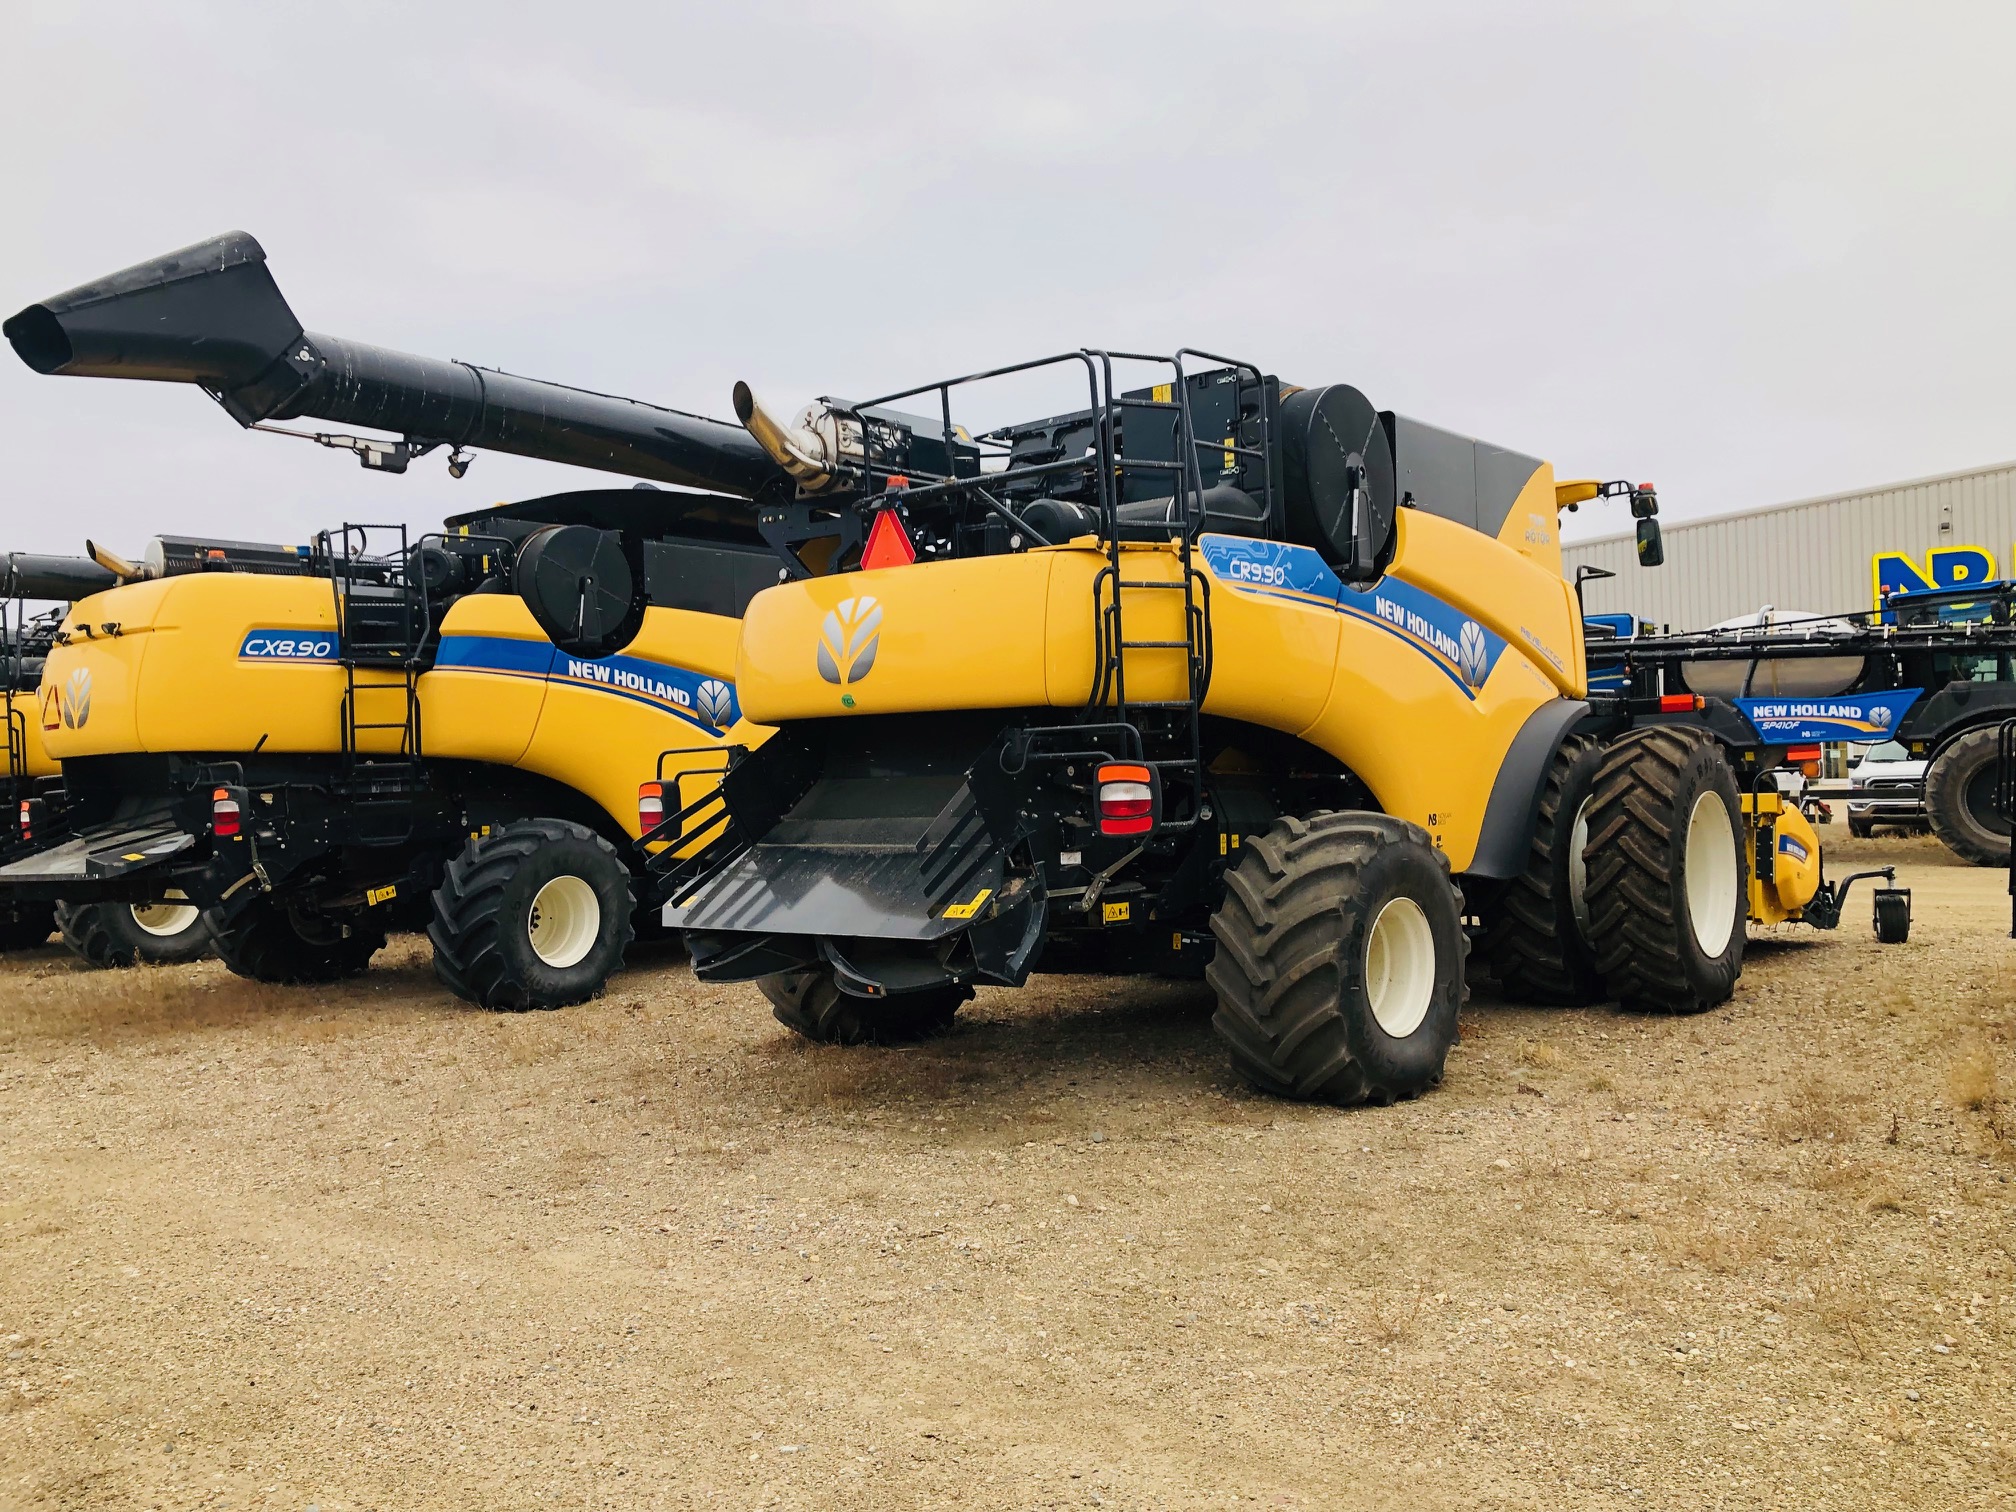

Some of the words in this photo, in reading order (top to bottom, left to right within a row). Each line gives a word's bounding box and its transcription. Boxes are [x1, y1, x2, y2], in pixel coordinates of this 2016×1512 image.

[1229, 560, 1285, 586] CR9.90
[1375, 595, 1405, 627] NEW
[1407, 609, 1460, 663] HOLLAND
[245, 639, 331, 657] CX8.90
[568, 660, 610, 681] NEW
[614, 669, 690, 707] HOLLAND
[1753, 705, 1788, 718] NEW
[1790, 704, 1862, 719] HOLLAND
[1761, 721, 1800, 730] SP410F
